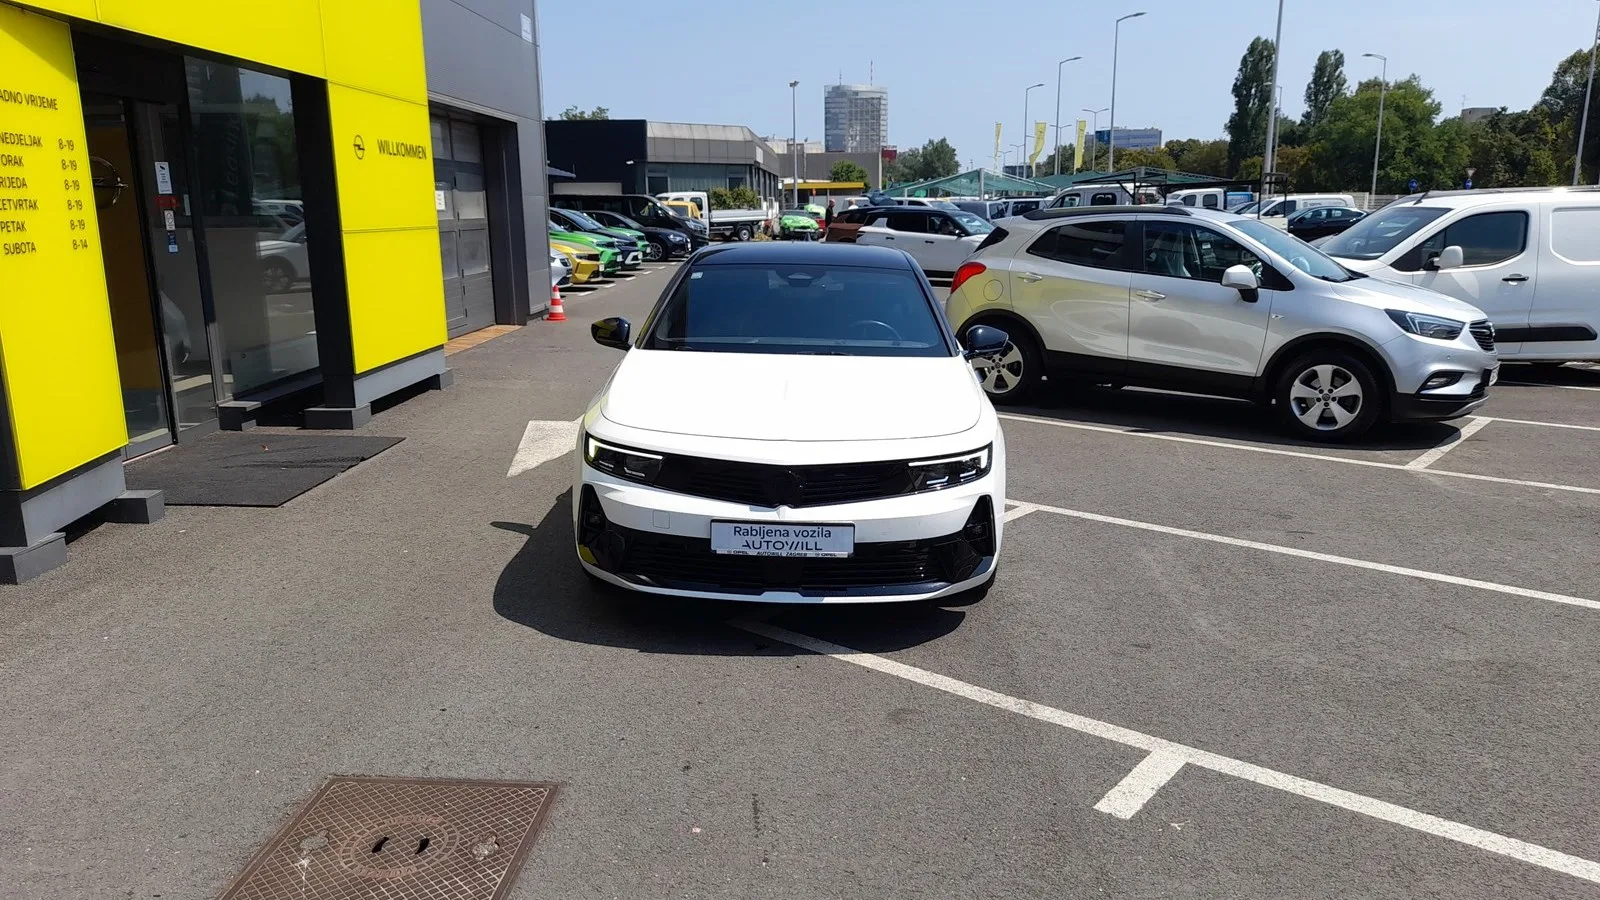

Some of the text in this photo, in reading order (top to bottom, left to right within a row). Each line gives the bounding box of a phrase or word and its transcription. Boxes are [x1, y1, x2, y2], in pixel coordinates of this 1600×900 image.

[24, 93, 58, 110] VRIJEME
[58, 138, 75, 151] 8-19
[377, 139, 427, 160] WILLKOMMEN
[0, 153, 77, 170] ORAK 8-19
[64, 179, 80, 191] 8-19
[67, 199, 83, 211] 8-19
[0, 219, 86, 233] PETAK 8-19
[3, 238, 88, 255] SUBOTA 8-14
[733, 526, 832, 540] Rabljena vozila
[742, 540, 823, 551] AUTOWILL
